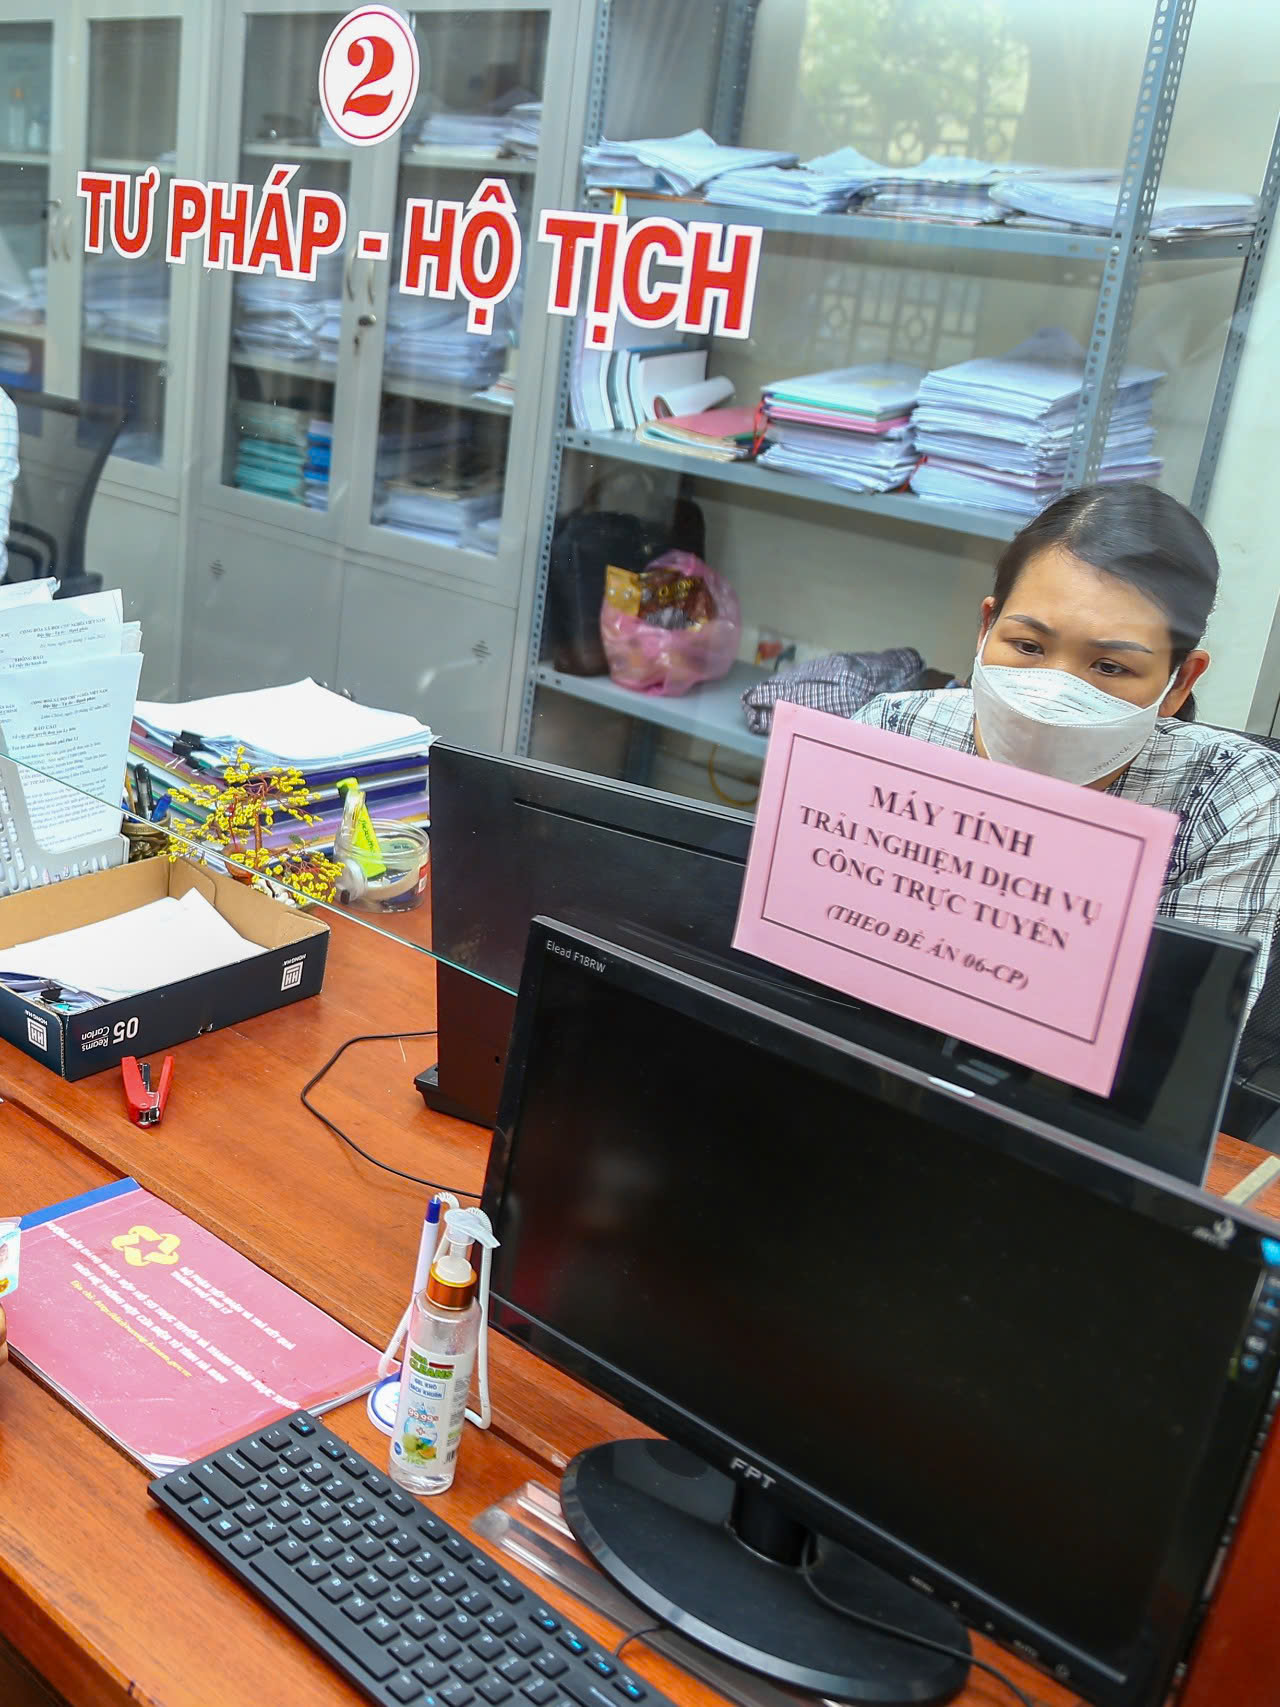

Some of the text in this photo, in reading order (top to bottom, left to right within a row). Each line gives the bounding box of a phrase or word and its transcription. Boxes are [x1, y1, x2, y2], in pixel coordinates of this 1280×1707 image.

[343, 35, 395, 117] 2
[79, 168, 158, 257] TƯ
[168, 166, 346, 279] PHÁP
[402, 179, 521, 333] HỘ
[541, 210, 763, 350] TỊCH
[870, 786, 1036, 858] MÁY TÍNH
[800, 805, 1103, 926] TRẢI NGHIỆM DỊCH VỤ
[812, 847, 885, 887] CÔNG
[892, 873, 967, 911] TRỰC
[546, 940, 607, 973] Elead F18RW
[826, 903, 1029, 991] (THEO ĐỀ ÁN 06-CP)
[81, 1025, 110, 1041] Carton
[81, 1036, 109, 1052] Reams
[112, 1016, 140, 1044] 05
[730, 1456, 776, 1489] FPT
